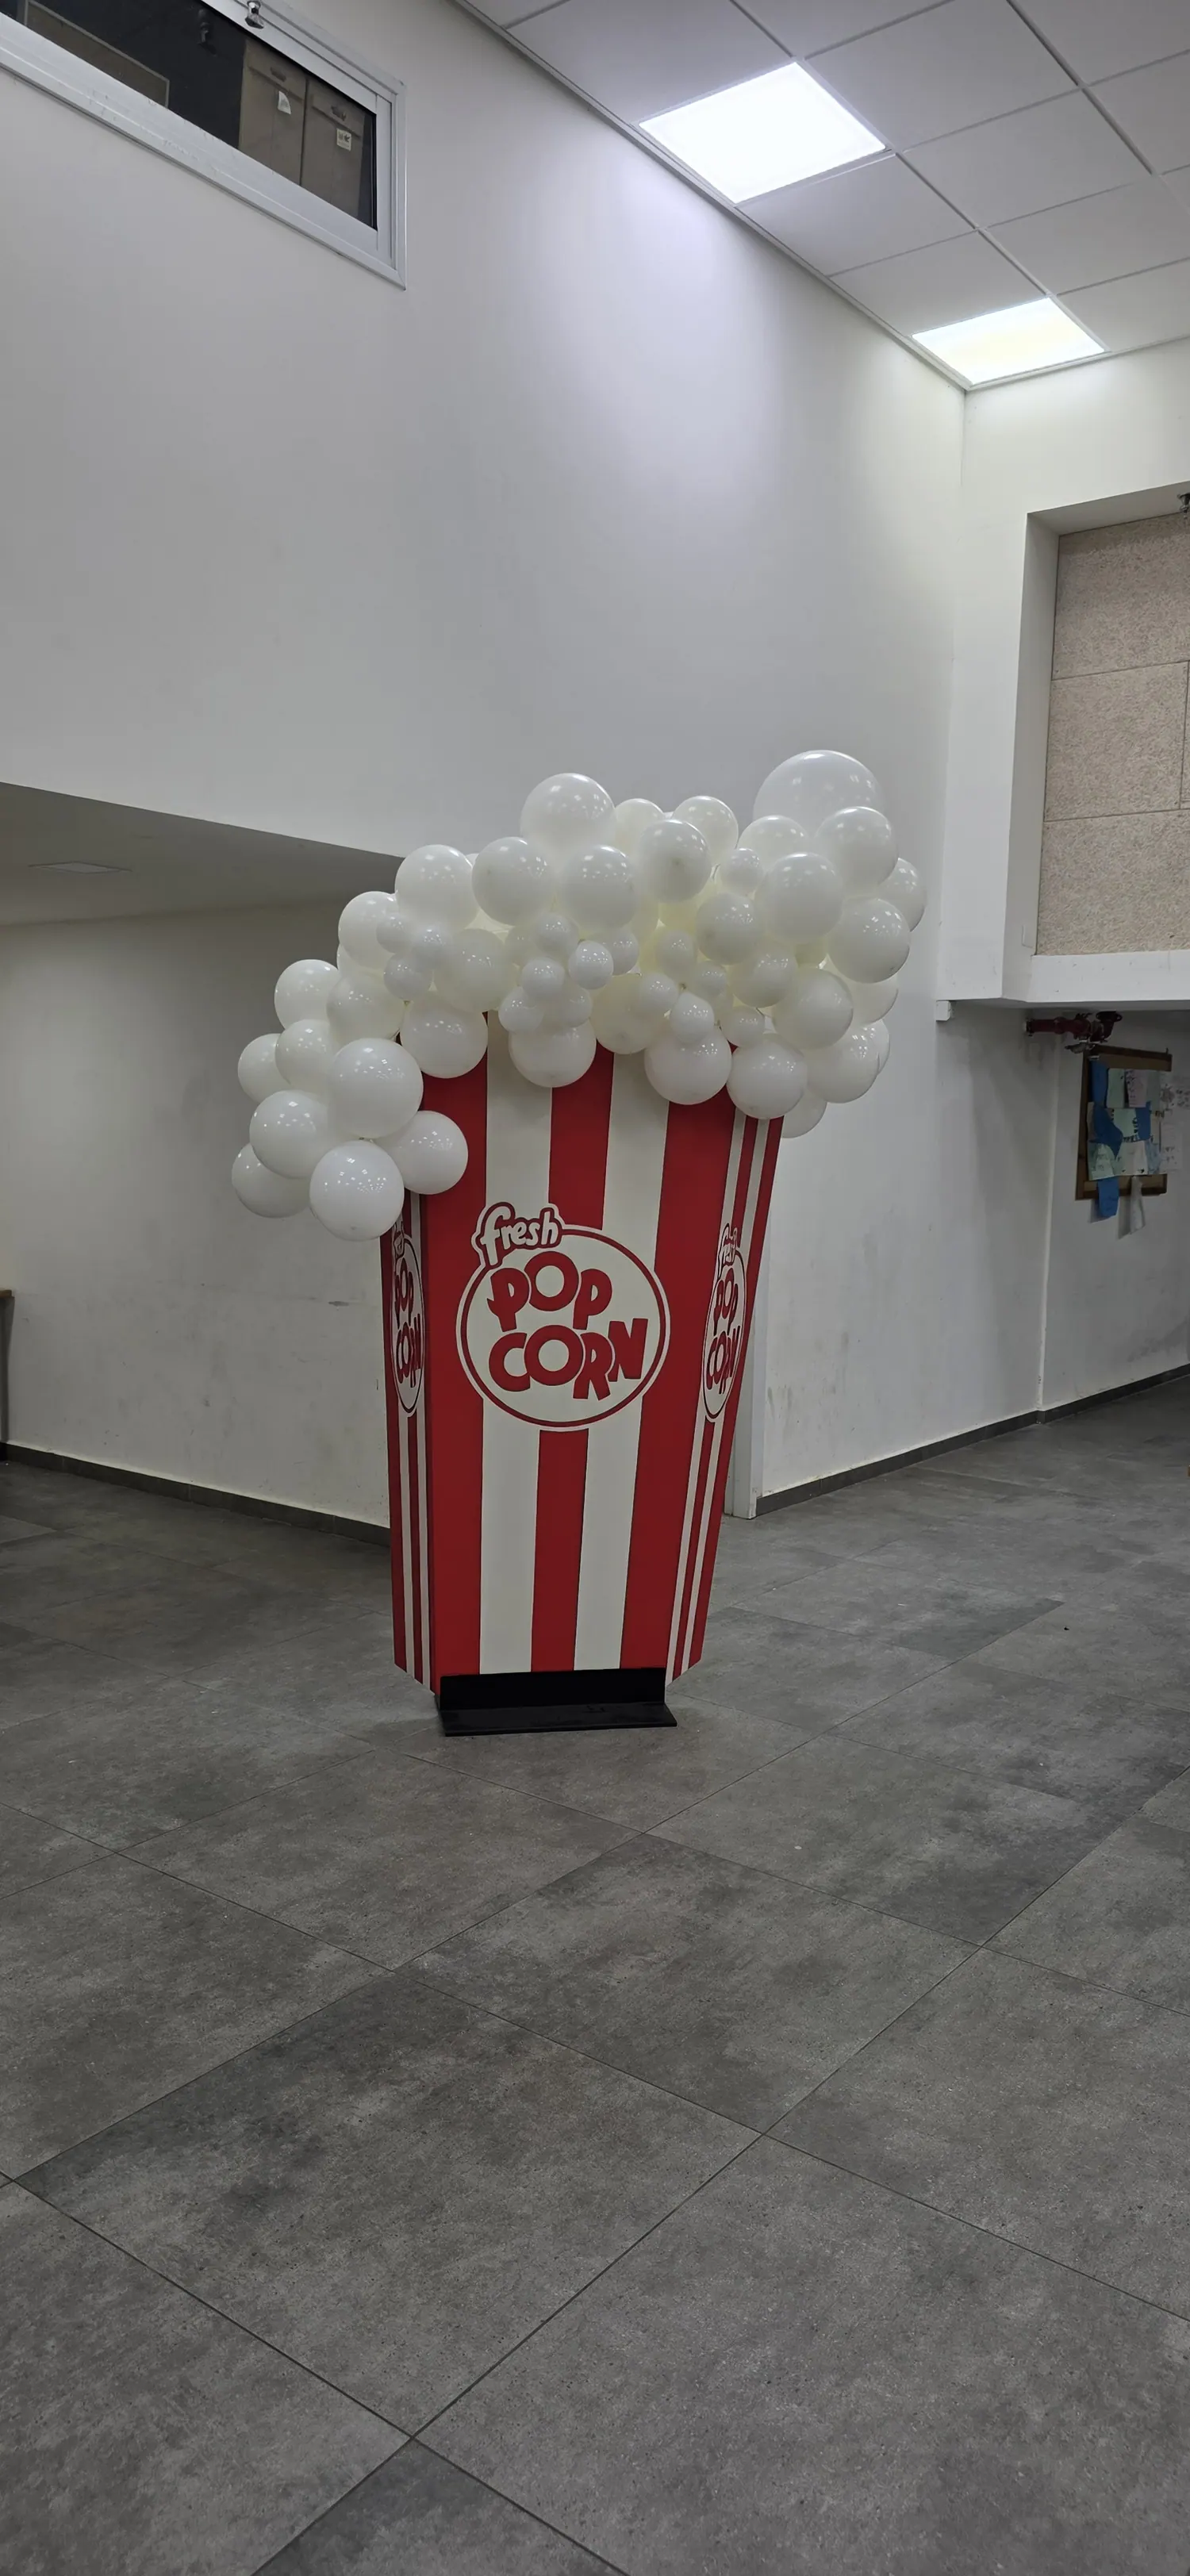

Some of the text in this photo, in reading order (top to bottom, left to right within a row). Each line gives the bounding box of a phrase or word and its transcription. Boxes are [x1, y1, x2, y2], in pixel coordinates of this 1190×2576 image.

[479, 1206, 559, 1267] fresh
[395, 1257, 415, 1329] POP
[486, 1250, 613, 1333] POP
[713, 1268, 739, 1337] POP
[488, 1318, 650, 1401] CORN
[706, 1325, 741, 1395] CORN
